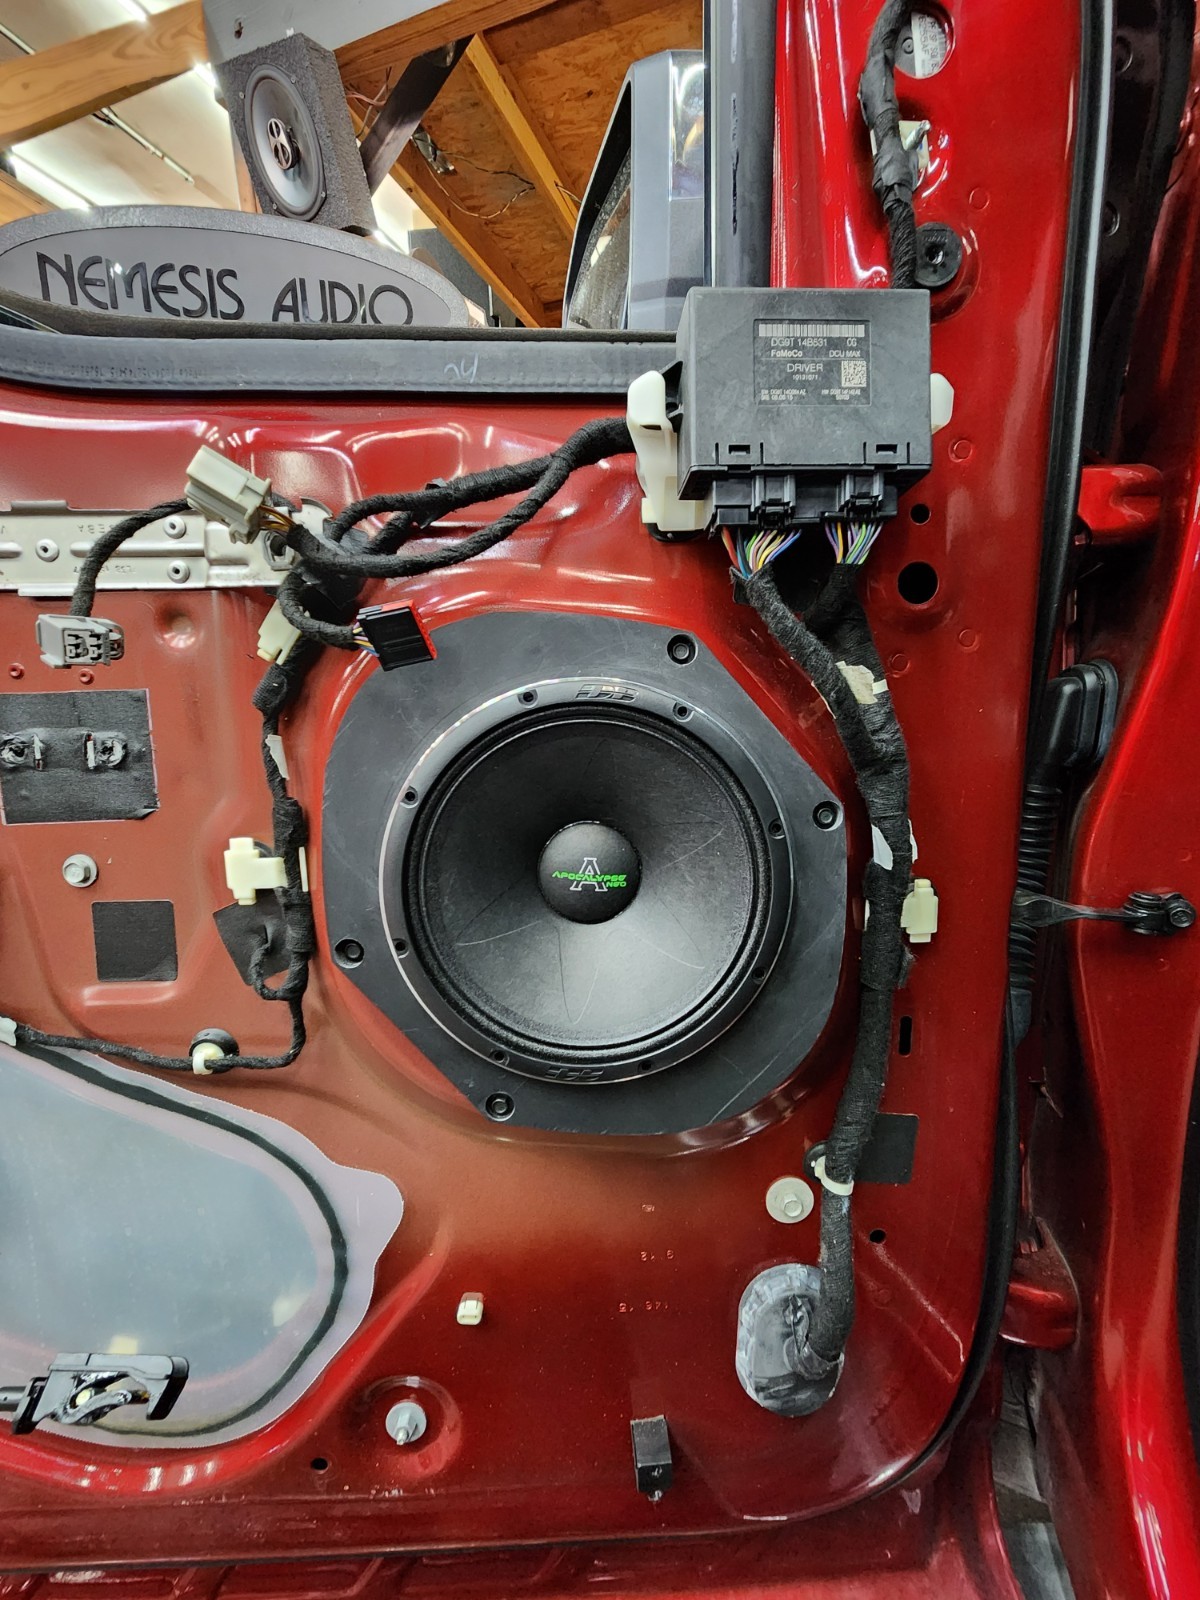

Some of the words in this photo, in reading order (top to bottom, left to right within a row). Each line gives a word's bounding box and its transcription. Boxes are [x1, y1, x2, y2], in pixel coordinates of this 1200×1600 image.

[36, 251, 246, 320] NEMESIS
[271, 276, 414, 325] AUDIO
[770, 338, 795, 346] DG9T
[798, 338, 828, 346] 14B531
[771, 349, 803, 357] FoMoCo
[845, 350, 861, 358] MAX
[787, 363, 824, 372] DRIVER
[552, 870, 627, 882] APOCALYPSE
